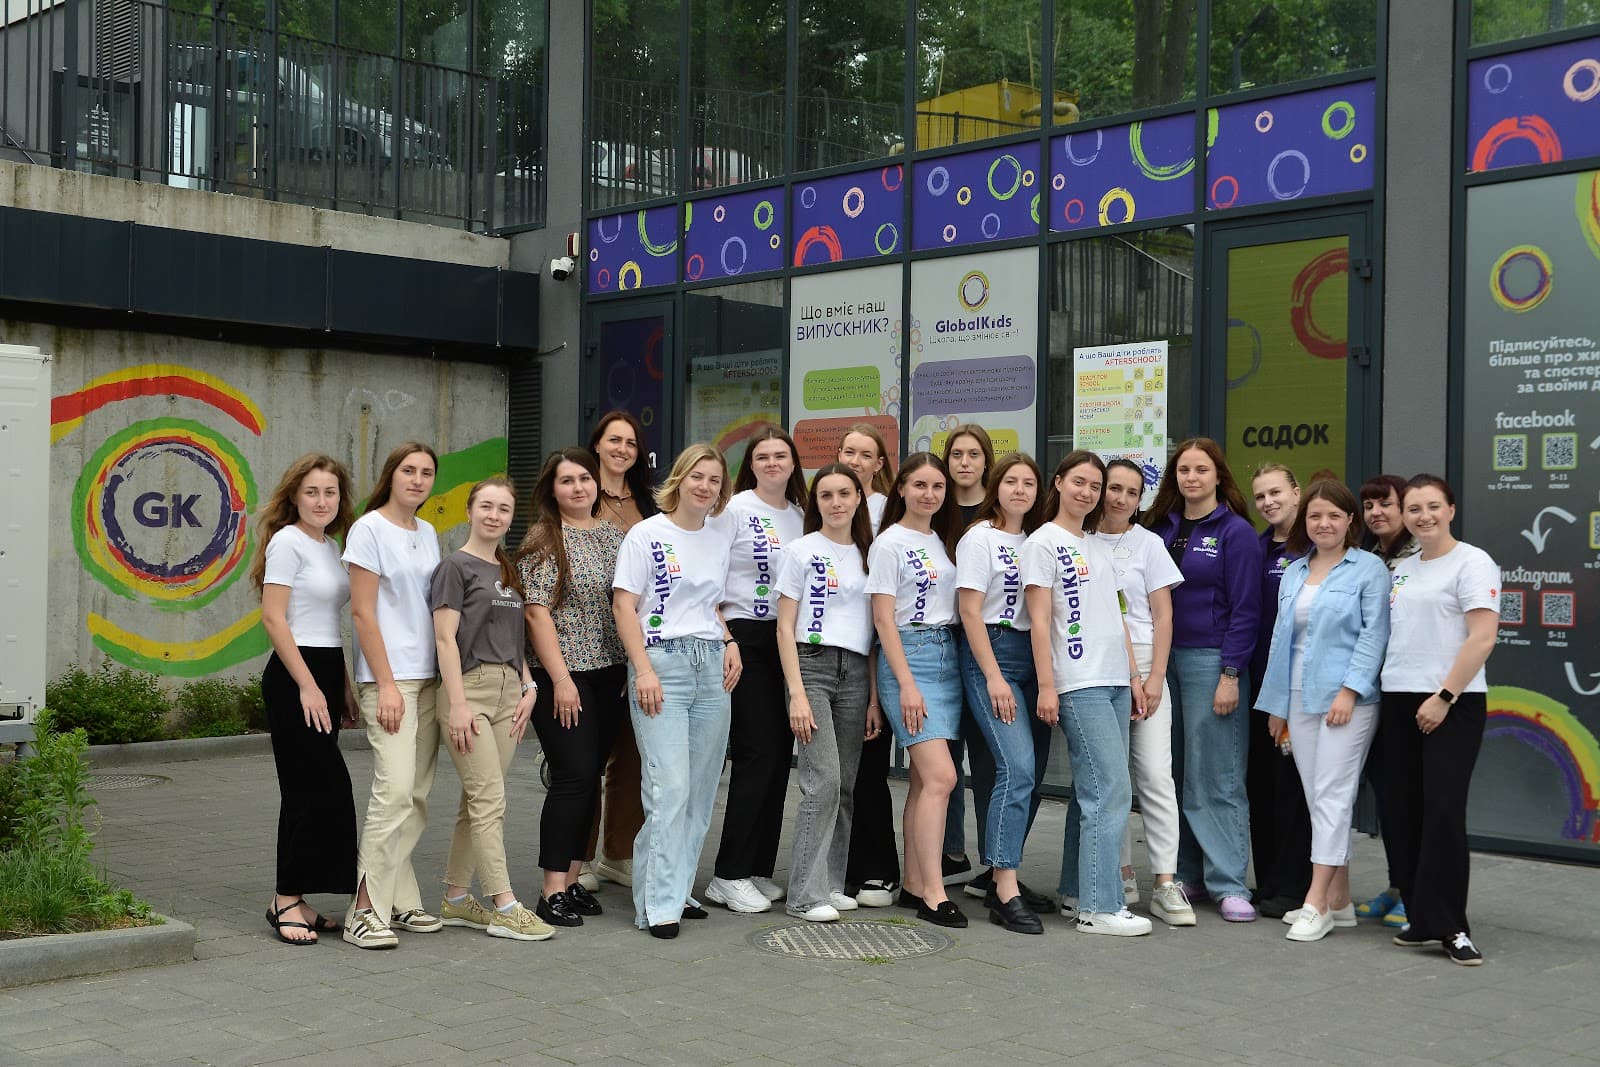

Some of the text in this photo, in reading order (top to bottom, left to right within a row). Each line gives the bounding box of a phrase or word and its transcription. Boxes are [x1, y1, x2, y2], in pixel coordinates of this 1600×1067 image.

[800, 300, 886, 321] Що вміє наш
[796, 317, 889, 341] ВИПУСКНИК?
[935, 315, 1012, 333] GlobalKids
[1489, 336, 1596, 353] Підписуйтесь,
[1104, 354, 1162, 367] AFTERSCHOOL?
[1488, 354, 1541, 367] більше
[1544, 352, 1573, 366] про
[1524, 369, 1540, 379] та
[1517, 383, 1534, 393] за
[1537, 378, 1588, 392] своїми
[1495, 408, 1576, 429] facebook
[132, 491, 203, 528] GK
[761, 517, 781, 552] TEAM
[663, 543, 682, 583] TEAM
[916, 548, 937, 590] TEAM
[1067, 546, 1090, 587] TEAM
[1501, 565, 1574, 590] nstagram
[1056, 546, 1083, 660] GlobalKids
